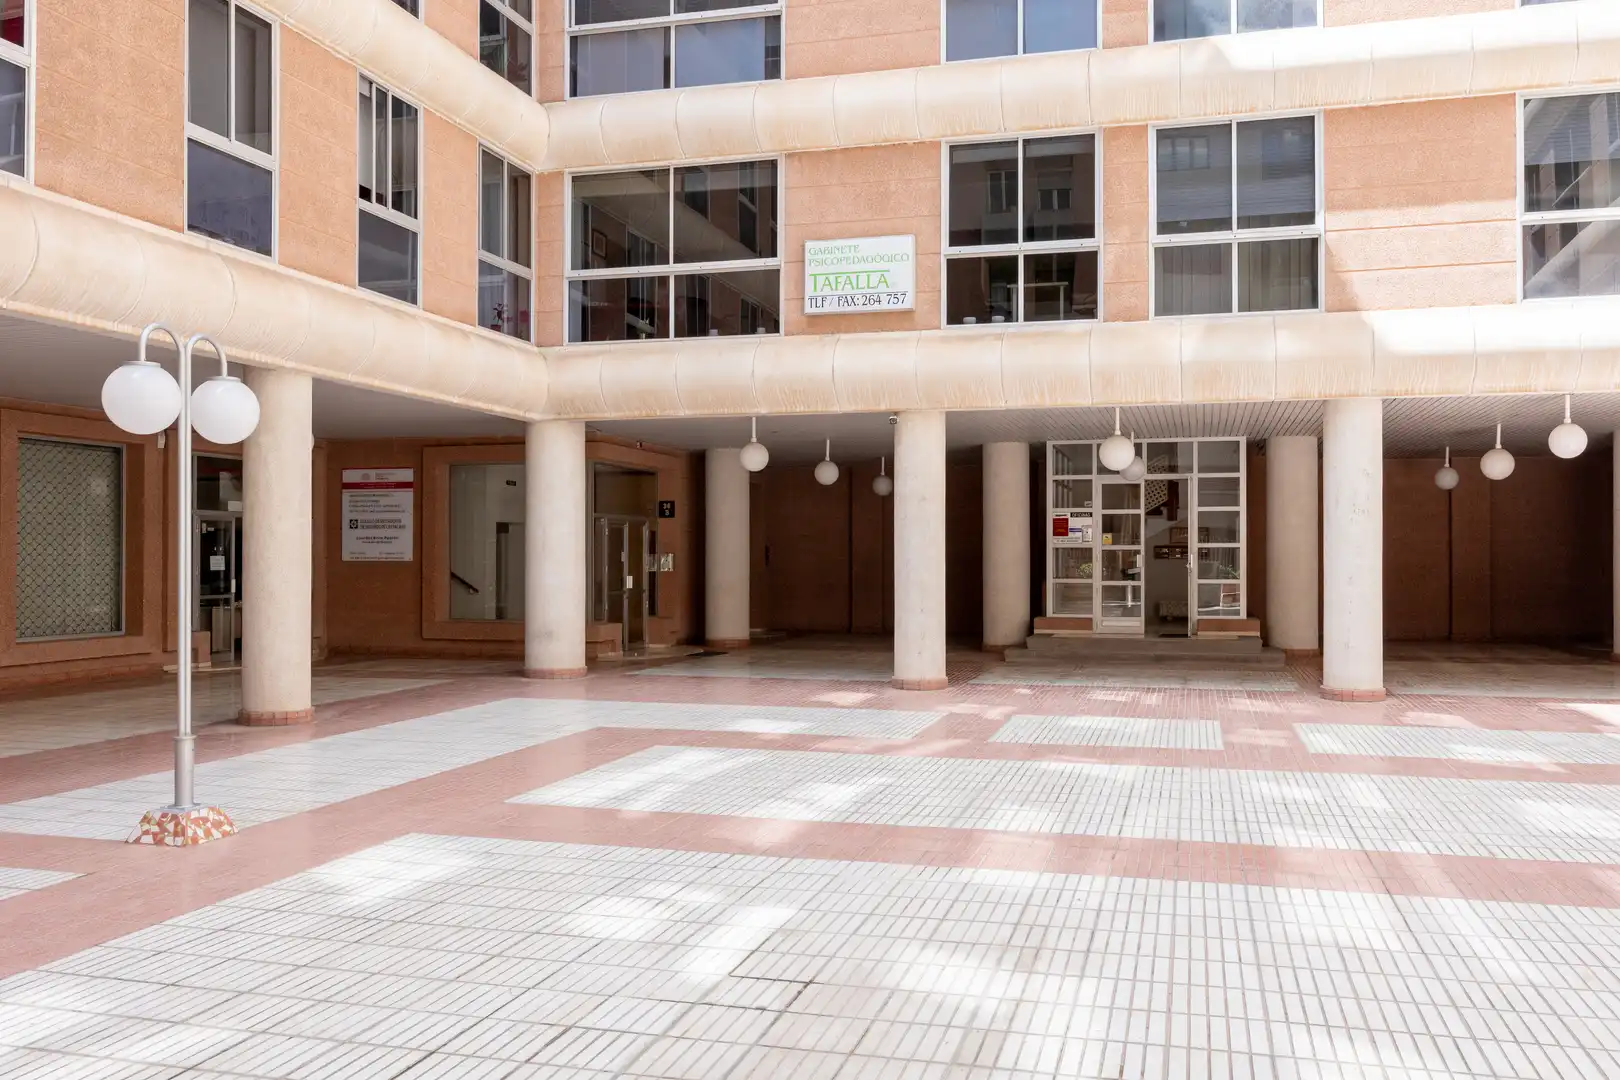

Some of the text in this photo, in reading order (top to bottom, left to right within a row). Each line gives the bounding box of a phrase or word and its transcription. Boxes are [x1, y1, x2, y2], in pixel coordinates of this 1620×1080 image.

[808, 245, 860, 256] GABINETE
[808, 253, 910, 267] PSICOPEDAGÓGICO
[809, 270, 890, 292] TAFALLA
[837, 295, 860, 307] FAX:
[861, 294, 882, 306] 264
[886, 293, 907, 304] 757
